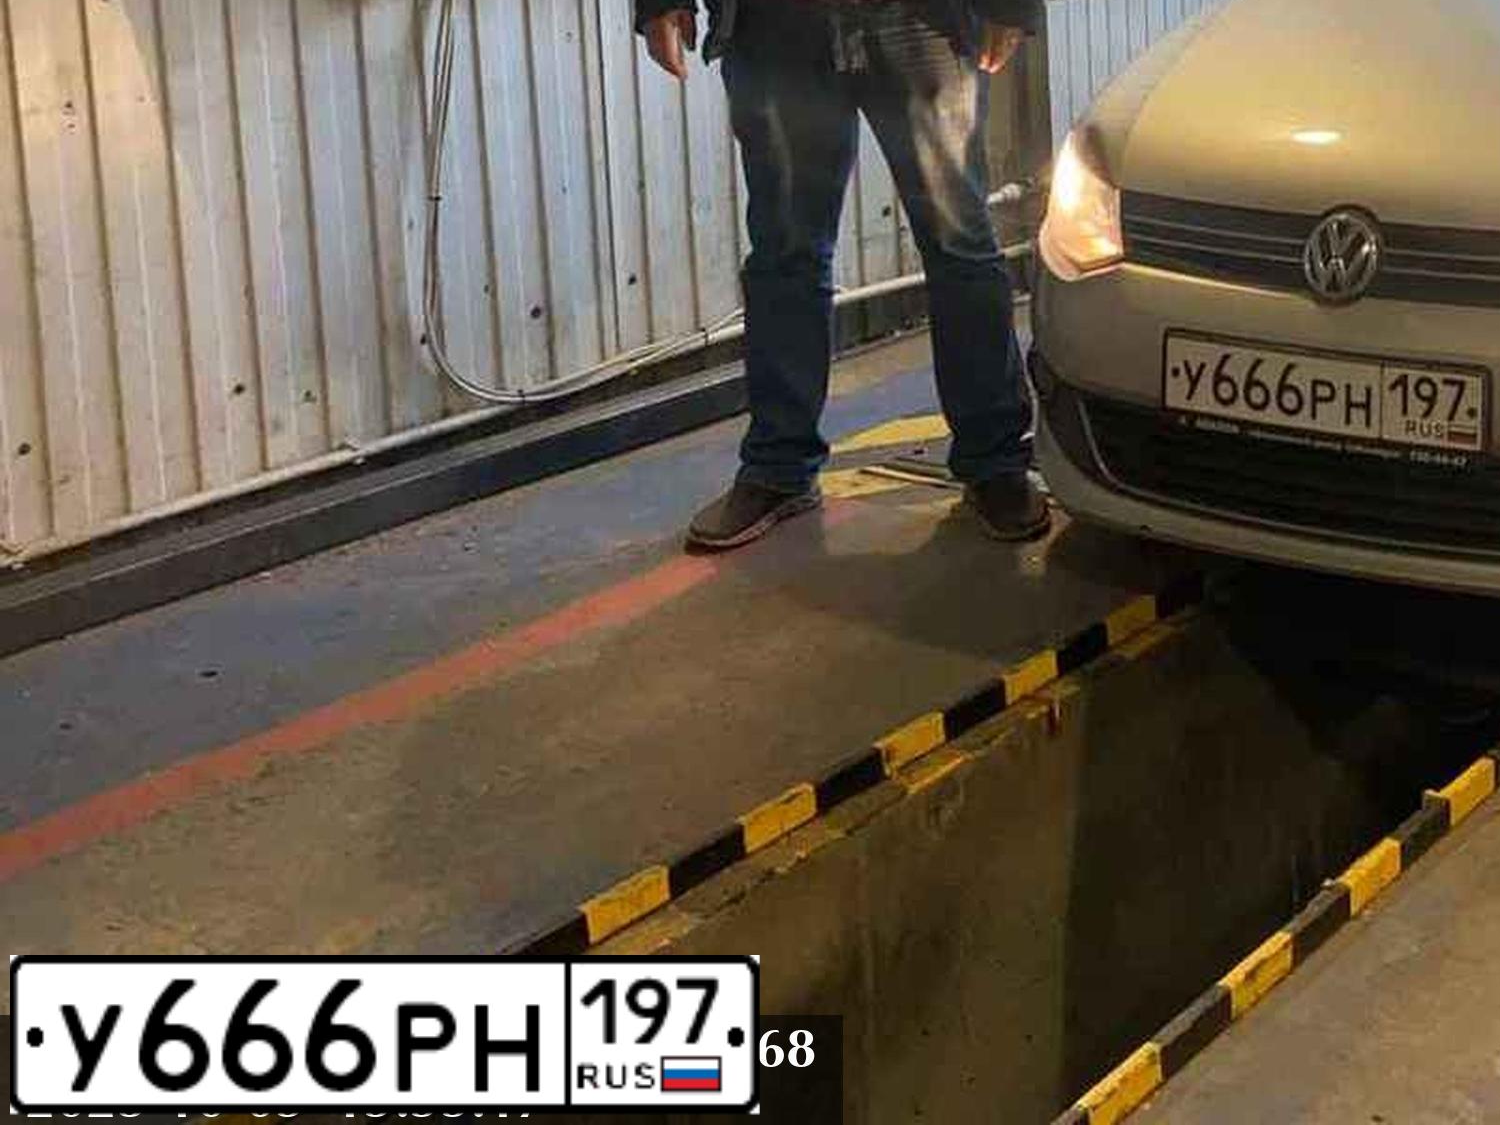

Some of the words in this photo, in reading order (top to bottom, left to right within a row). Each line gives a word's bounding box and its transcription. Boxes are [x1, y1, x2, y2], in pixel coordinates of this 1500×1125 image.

[1182, 354, 1373, 428] У666РН
[1388, 374, 1467, 421] 197
[1404, 421, 1445, 438] RUS
